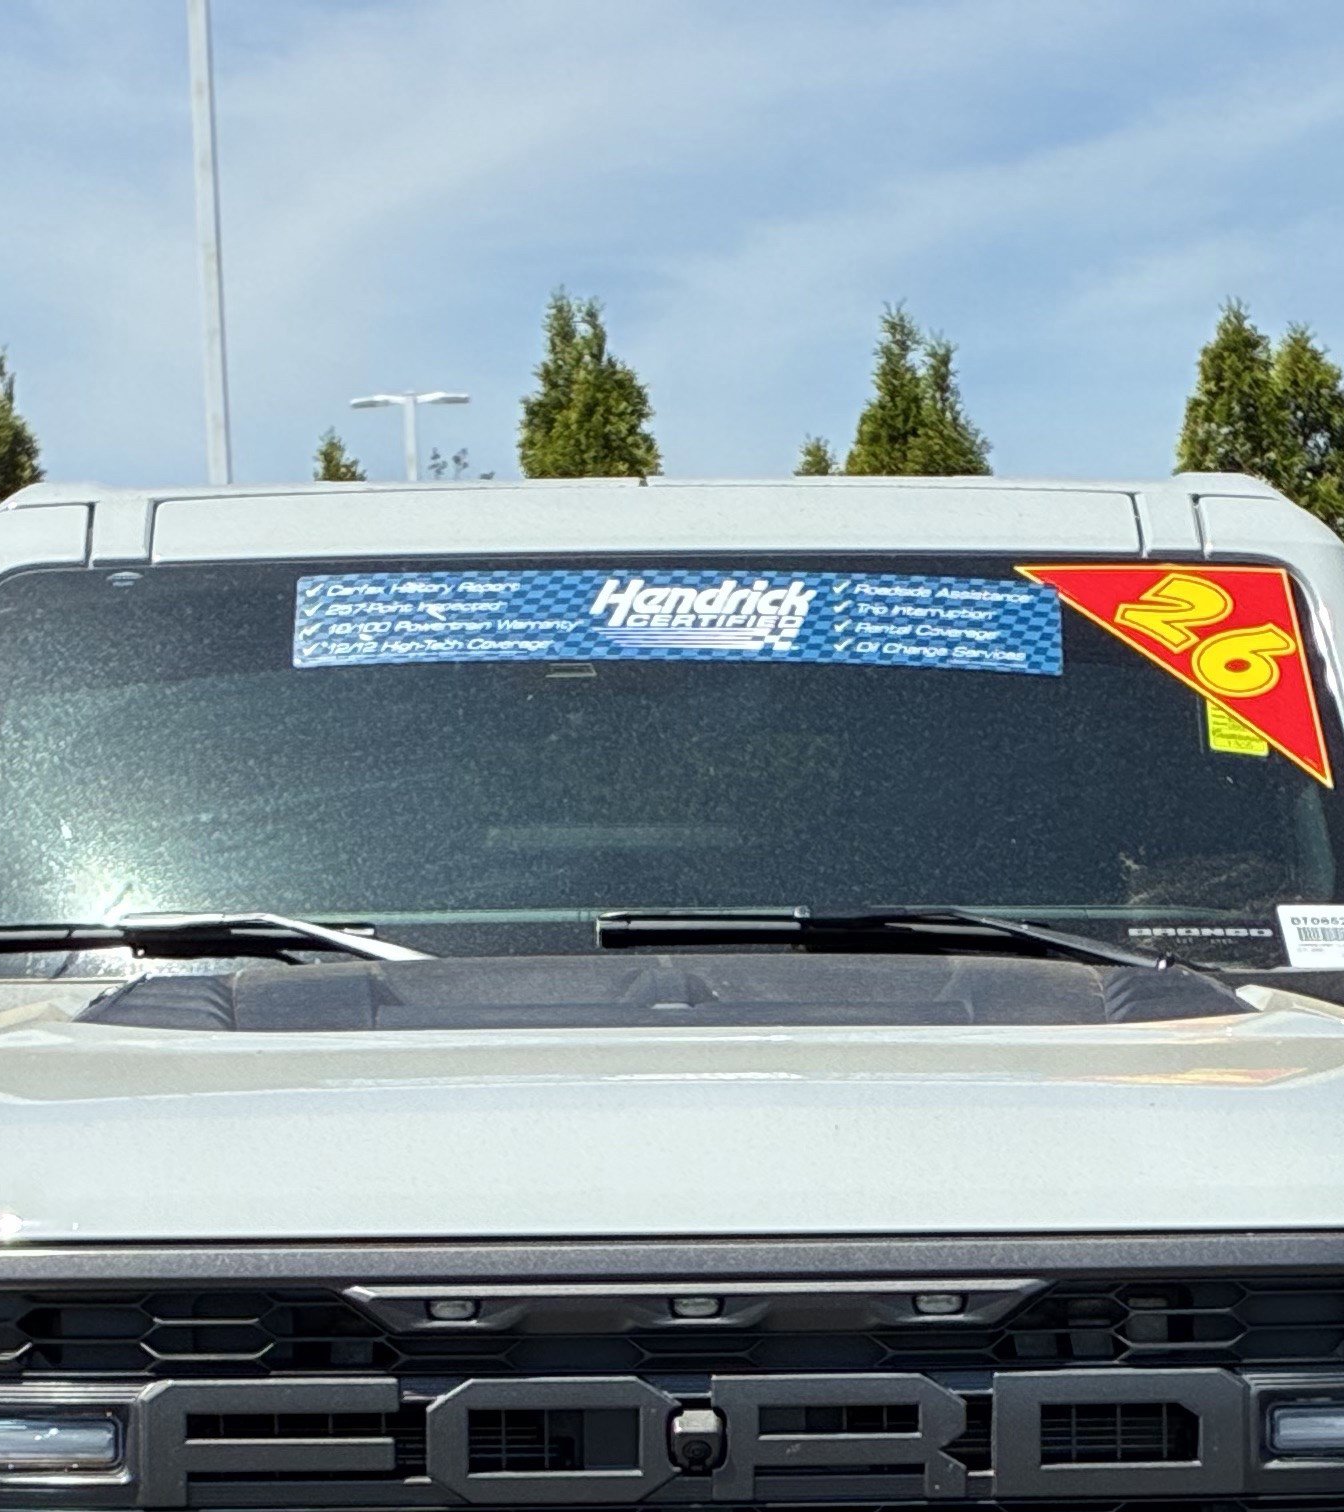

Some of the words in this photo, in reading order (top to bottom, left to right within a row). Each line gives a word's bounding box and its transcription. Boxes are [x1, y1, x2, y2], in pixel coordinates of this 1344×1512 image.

[326, 584, 385, 596] Carfax
[854, 583, 933, 598] Roadside
[935, 587, 1035, 604] Assistance
[589, 579, 817, 627] Hendrick
[857, 602, 889, 617] Trip
[626, 613, 805, 629] CERTIFIED
[855, 621, 913, 636] Rental
[1113, 573, 1297, 698] 26
[856, 641, 881, 654] Oil
[882, 642, 948, 657] Change
[953, 646, 1027, 662] Services
[137, 1368, 1250, 1506] FORD
